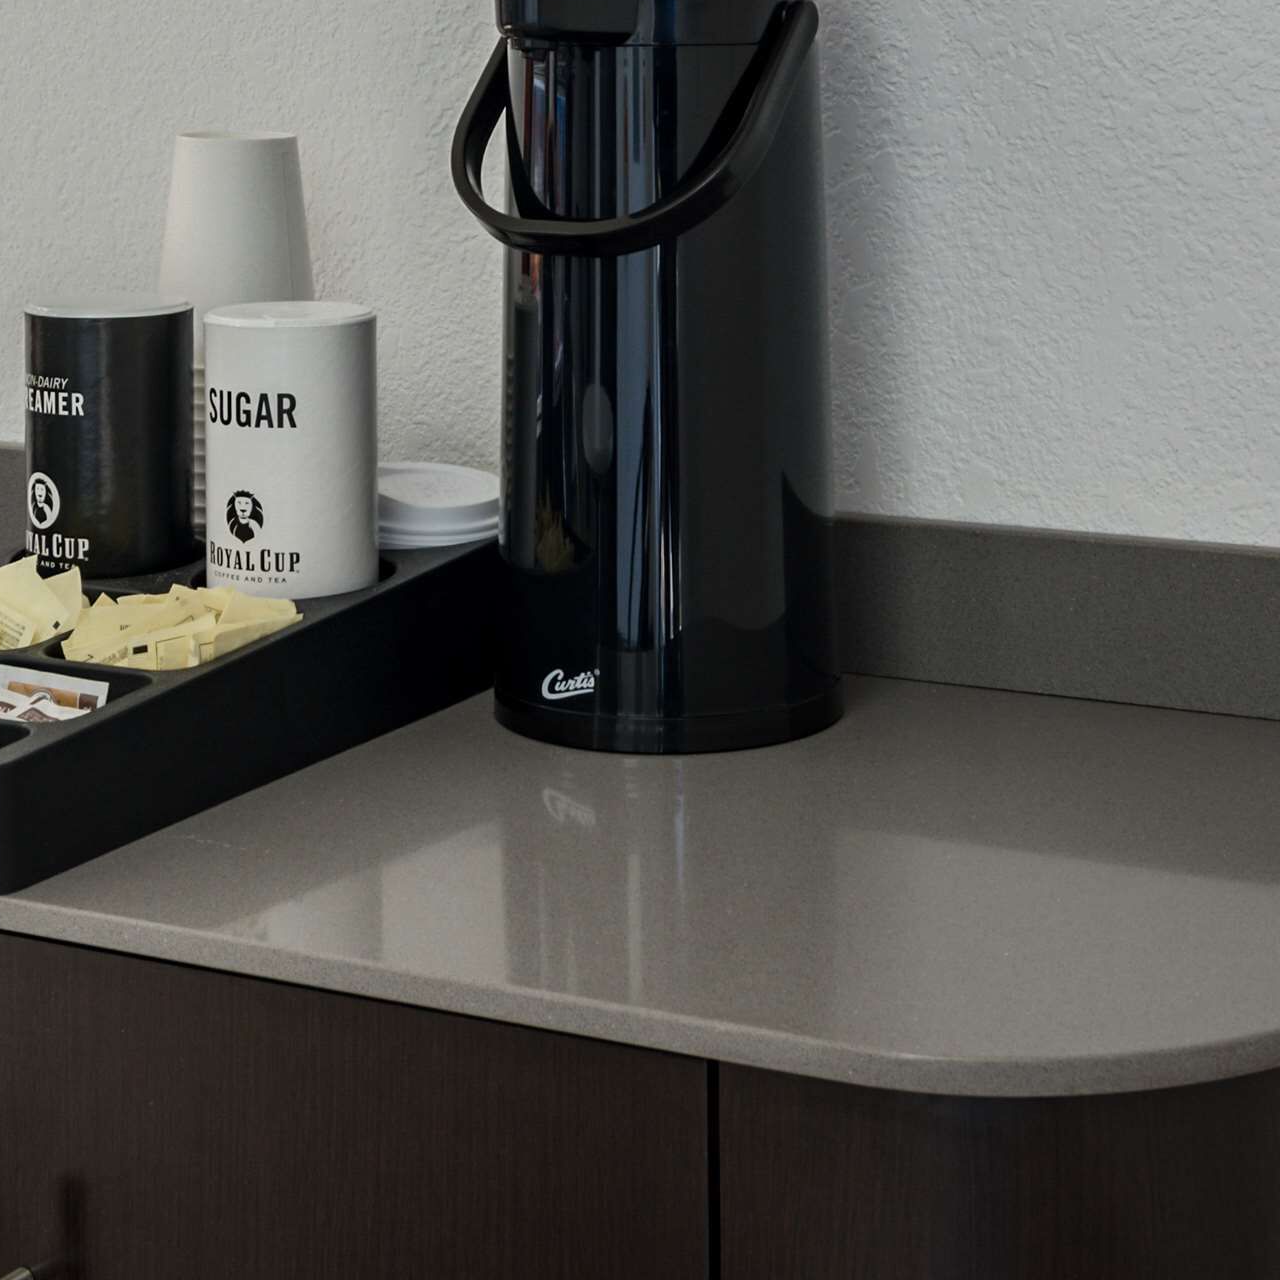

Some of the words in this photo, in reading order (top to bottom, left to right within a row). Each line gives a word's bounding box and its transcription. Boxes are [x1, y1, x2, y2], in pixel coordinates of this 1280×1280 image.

[26, 373, 69, 390] ON-DAIRY
[209, 387, 297, 428] SUGAR
[52, 533, 90, 560] CUP
[210, 540, 255, 572] ROYAL
[260, 548, 301, 573] CUP
[40, 560, 56, 569] AND
[214, 569, 240, 581] COFFEE
[244, 575, 263, 584] AND
[541, 668, 595, 700] Curtis
